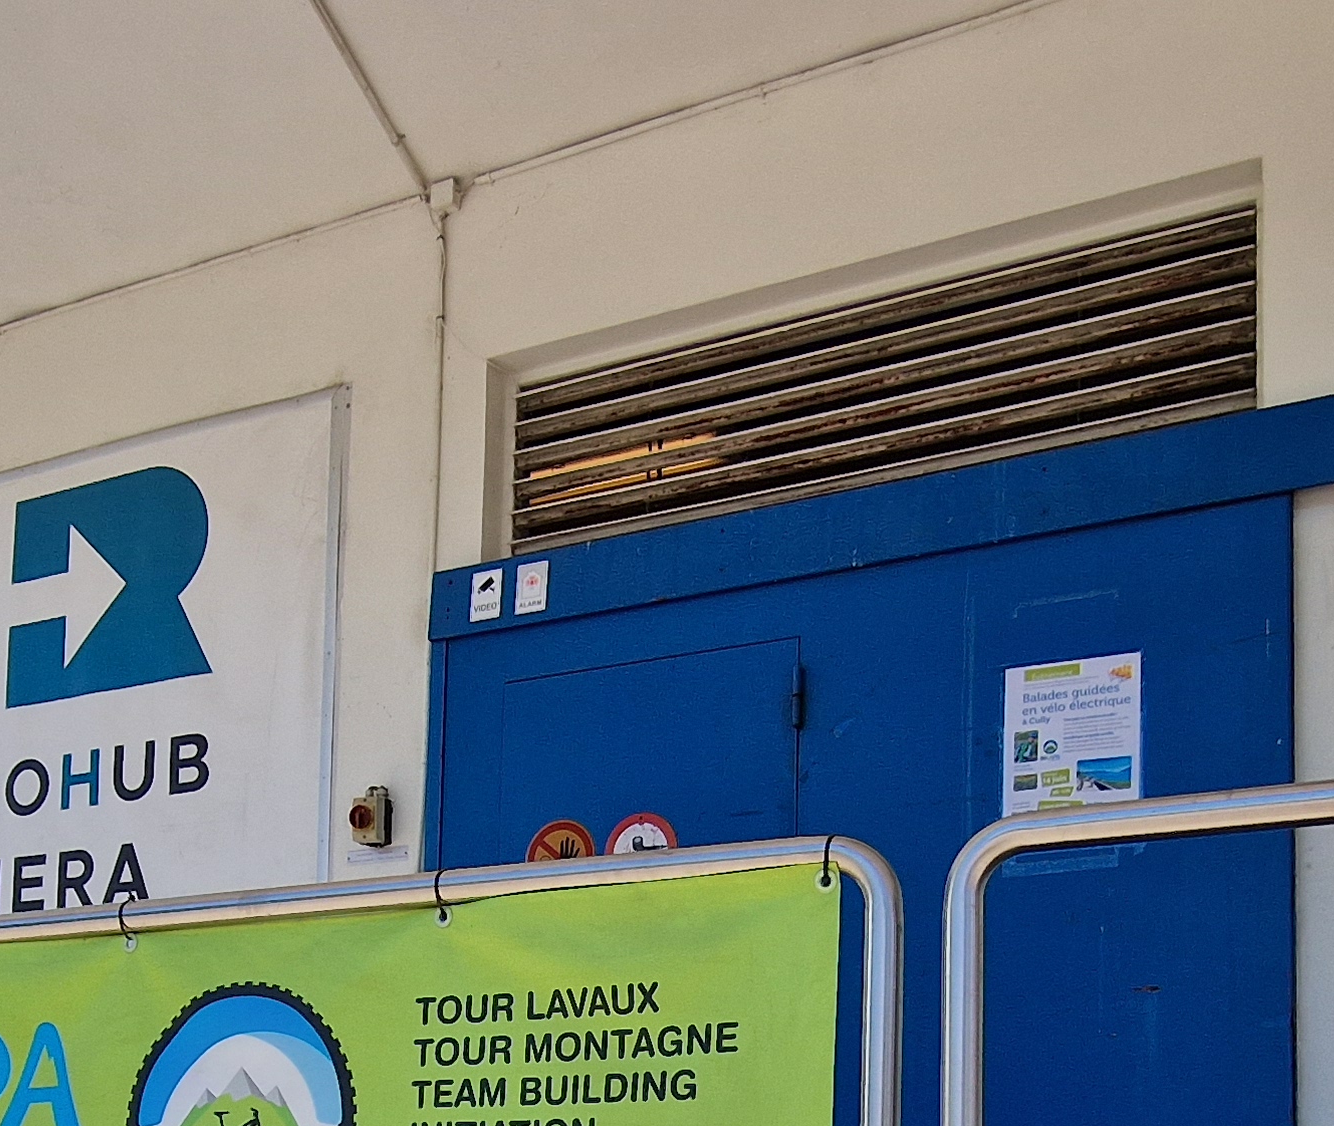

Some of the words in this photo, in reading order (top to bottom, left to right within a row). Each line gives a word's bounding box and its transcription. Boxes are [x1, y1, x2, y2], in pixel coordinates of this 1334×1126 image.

[473, 602, 497, 613] VIDEO
[519, 599, 542, 608] ALARM
[1022, 688, 1068, 703] Balades
[1071, 683, 1120, 700] guidées
[1022, 708, 1037, 716] en
[1040, 699, 1066, 714] vélo
[1069, 694, 1132, 711] électrique
[1028, 716, 1051, 725] Cully
[415, 993, 514, 1025] TOUR
[526, 981, 659, 1021] LAVAUX
[413, 1035, 512, 1067] TOUR
[524, 1021, 739, 1063] MONTAGNE
[411, 1077, 506, 1109] TEAM
[519, 1069, 697, 1106] BUILDING
